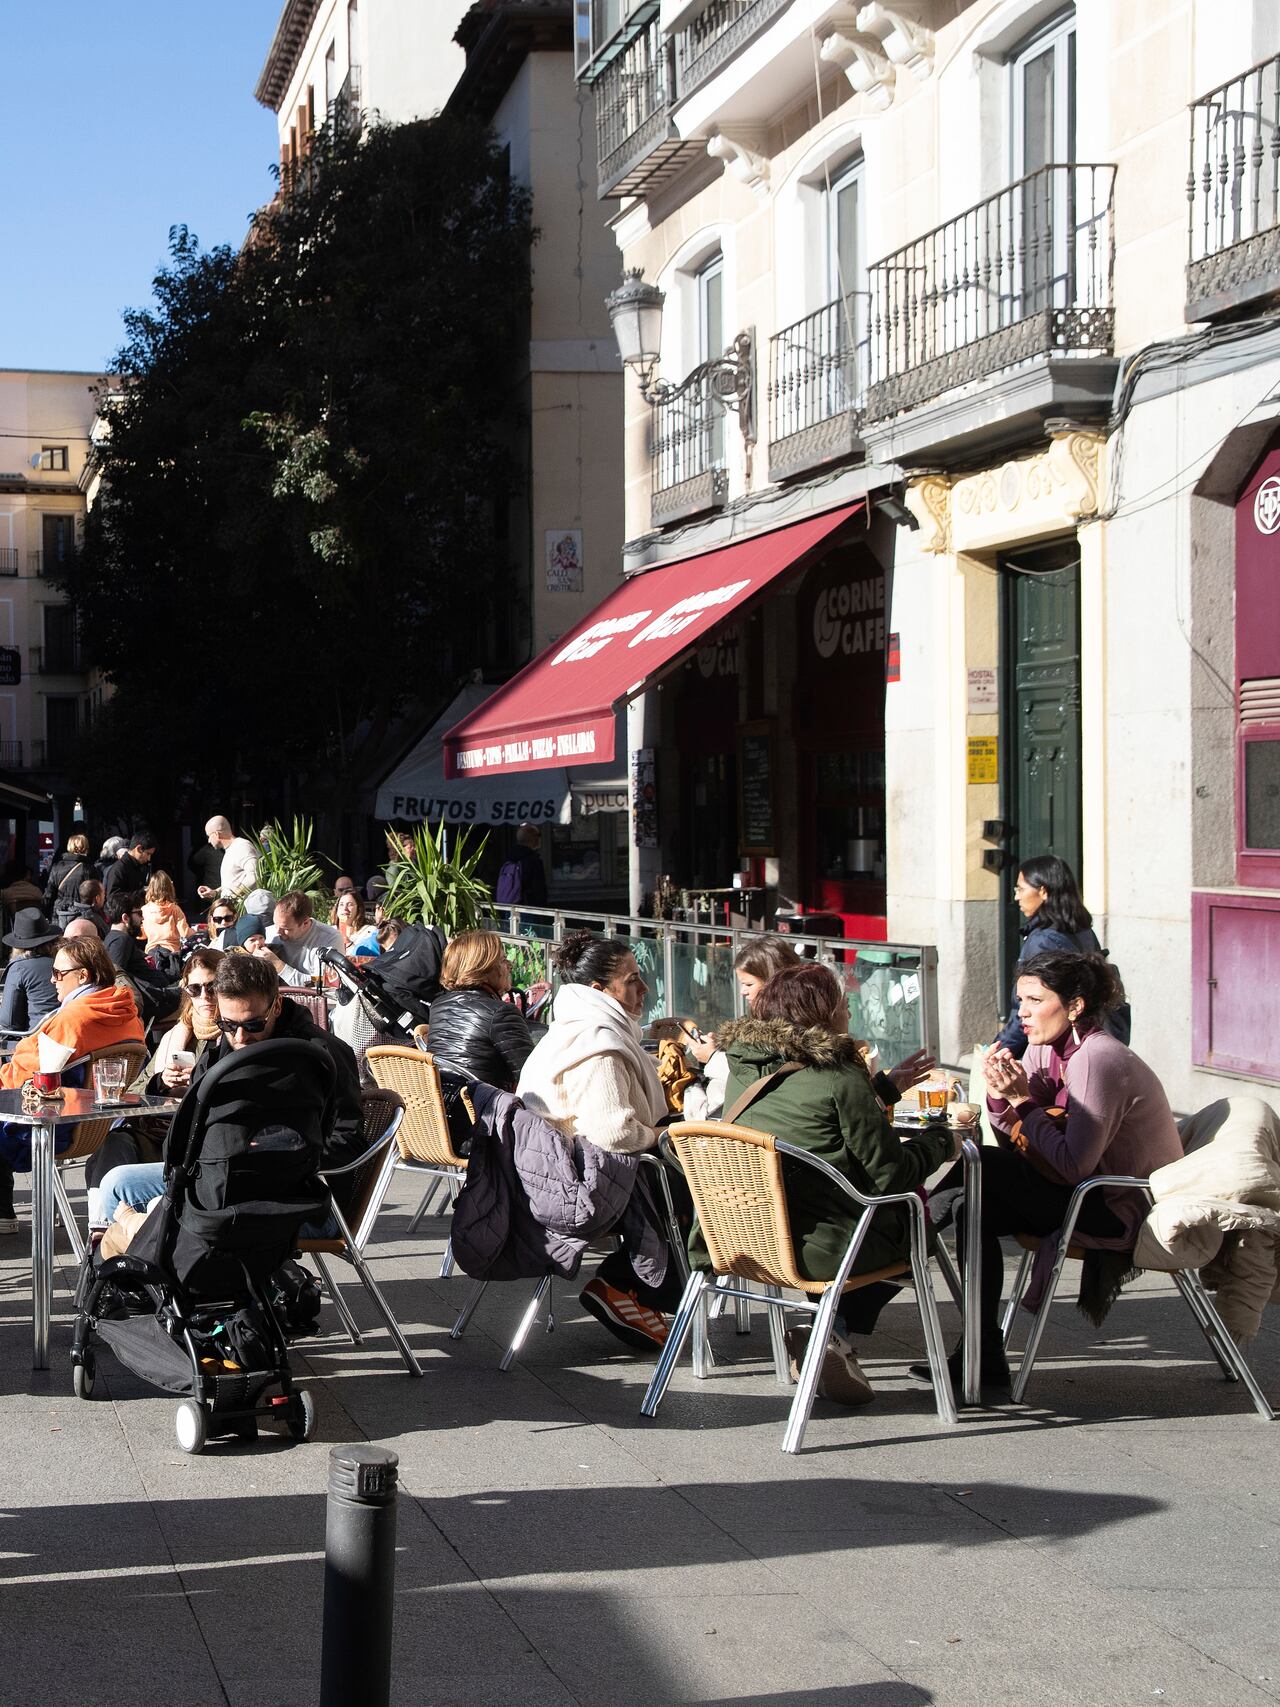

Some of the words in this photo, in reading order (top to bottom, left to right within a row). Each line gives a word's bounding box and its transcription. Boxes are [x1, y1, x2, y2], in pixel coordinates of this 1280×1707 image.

[392, 795, 477, 820] FRUTOS
[490, 798, 556, 820] SECOS
[585, 792, 629, 808] DULC
